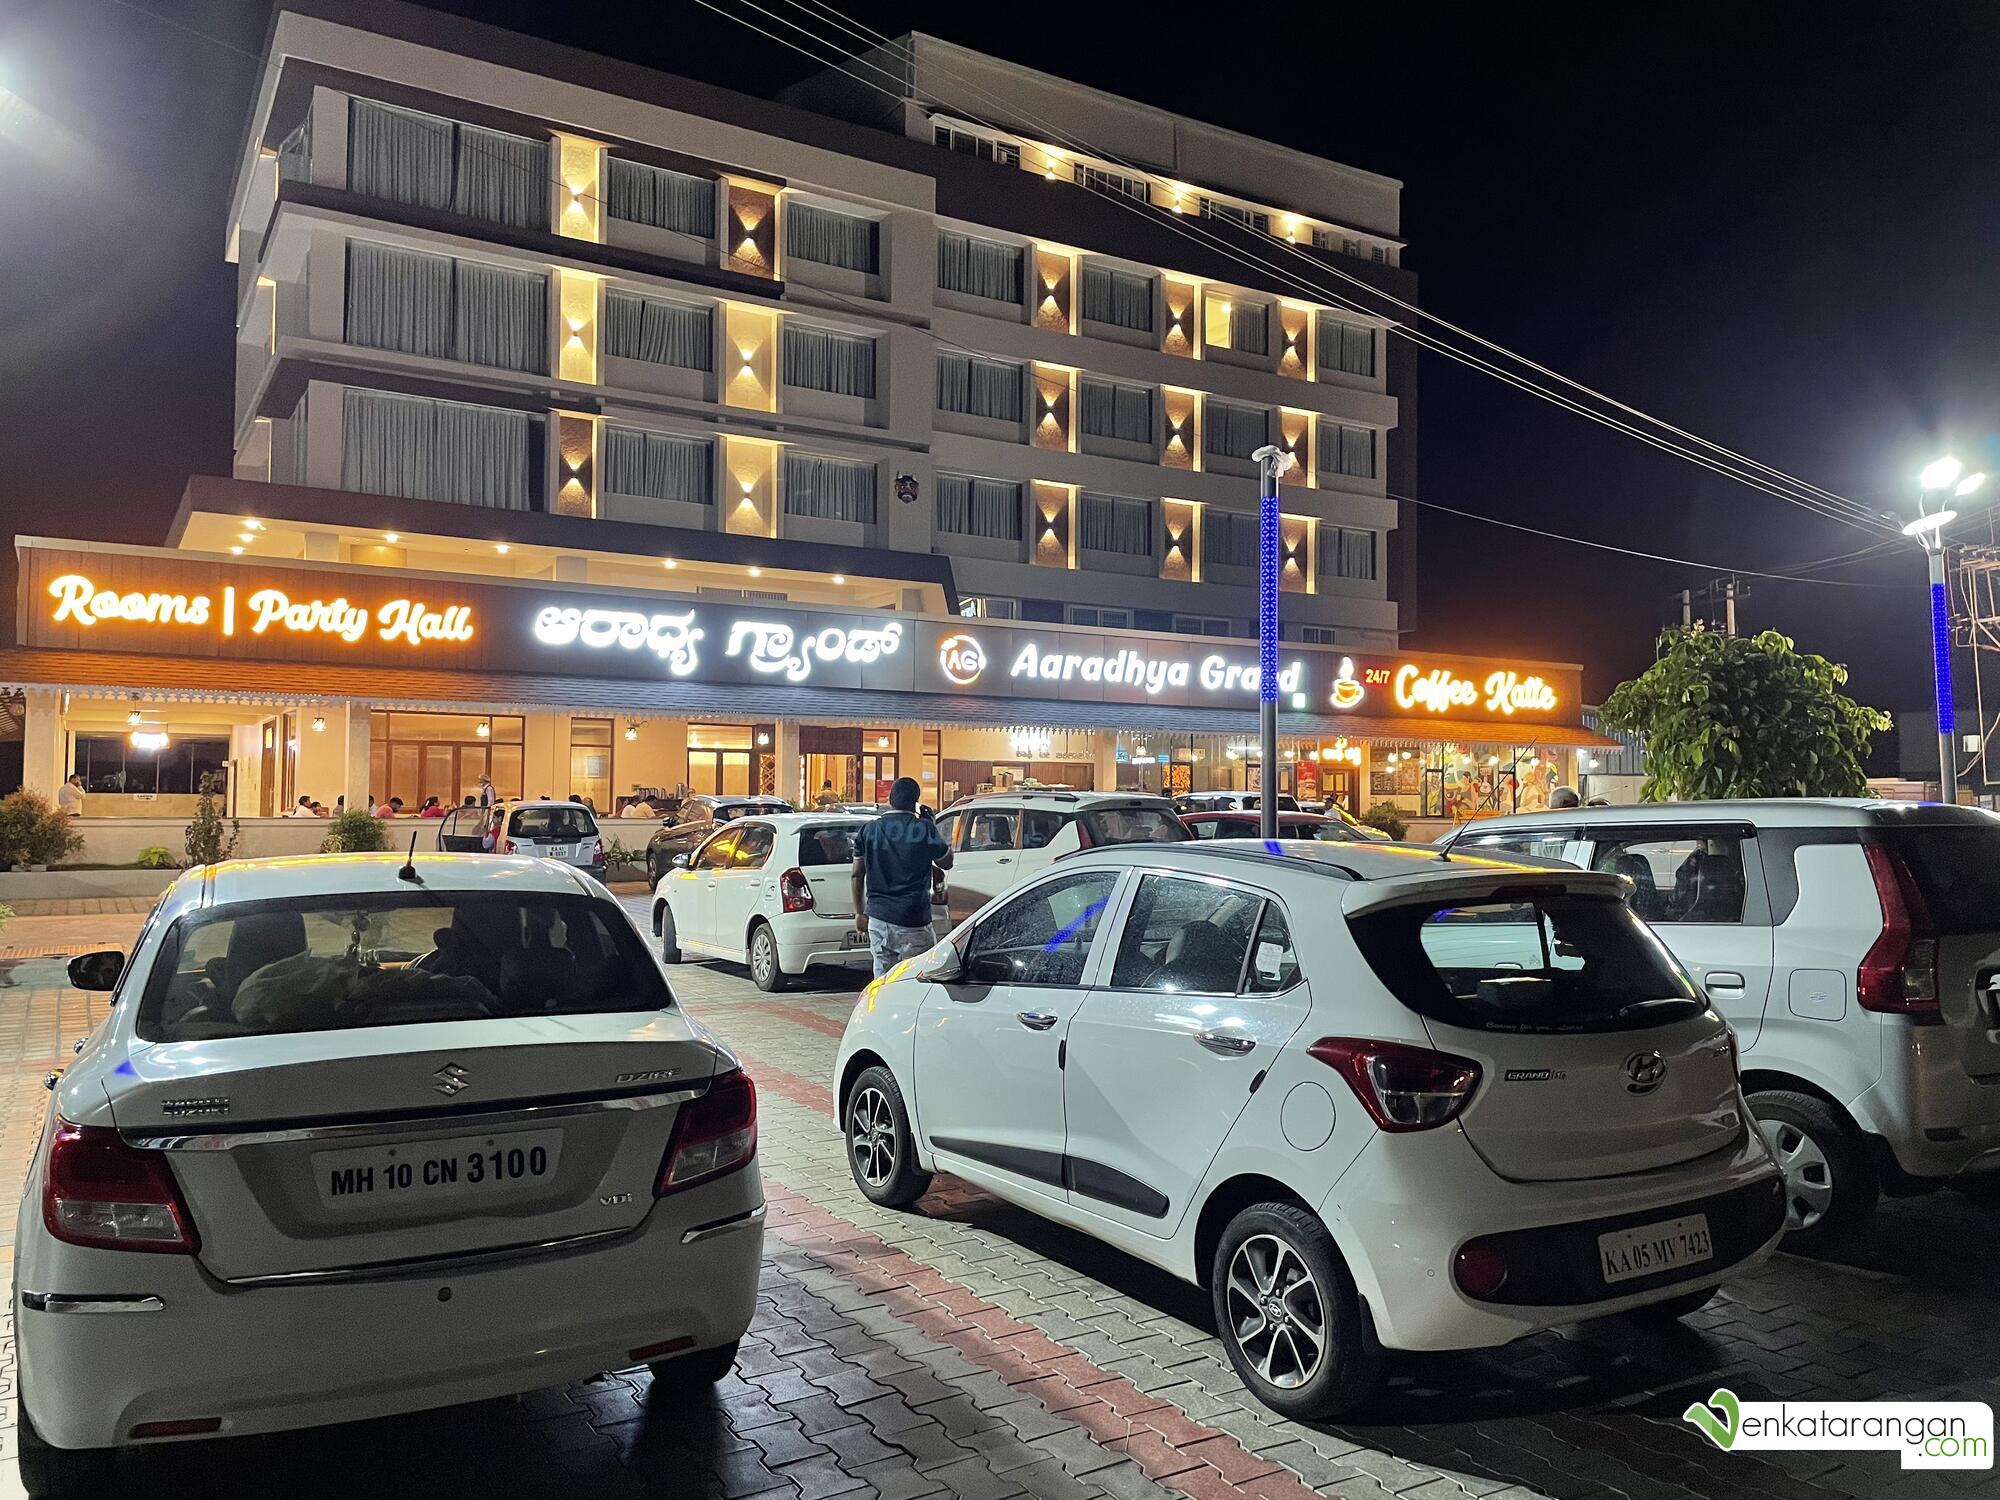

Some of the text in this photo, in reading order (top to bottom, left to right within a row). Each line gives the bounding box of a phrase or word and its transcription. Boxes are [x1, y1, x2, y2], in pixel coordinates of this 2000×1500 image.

[48, 574, 210, 626] Rooms
[248, 589, 368, 641] Party
[377, 599, 475, 645] Hall
[1010, 643, 1302, 694] Aaradhya Grad
[1365, 668, 1391, 684] 24/7
[1395, 664, 1479, 713] Coffee
[1507, 1071, 1549, 1081] GRAND
[331, 1146, 547, 1196] MH 10 CN 3100
[1605, 1230, 1710, 1276] KA 05 MV 7423
